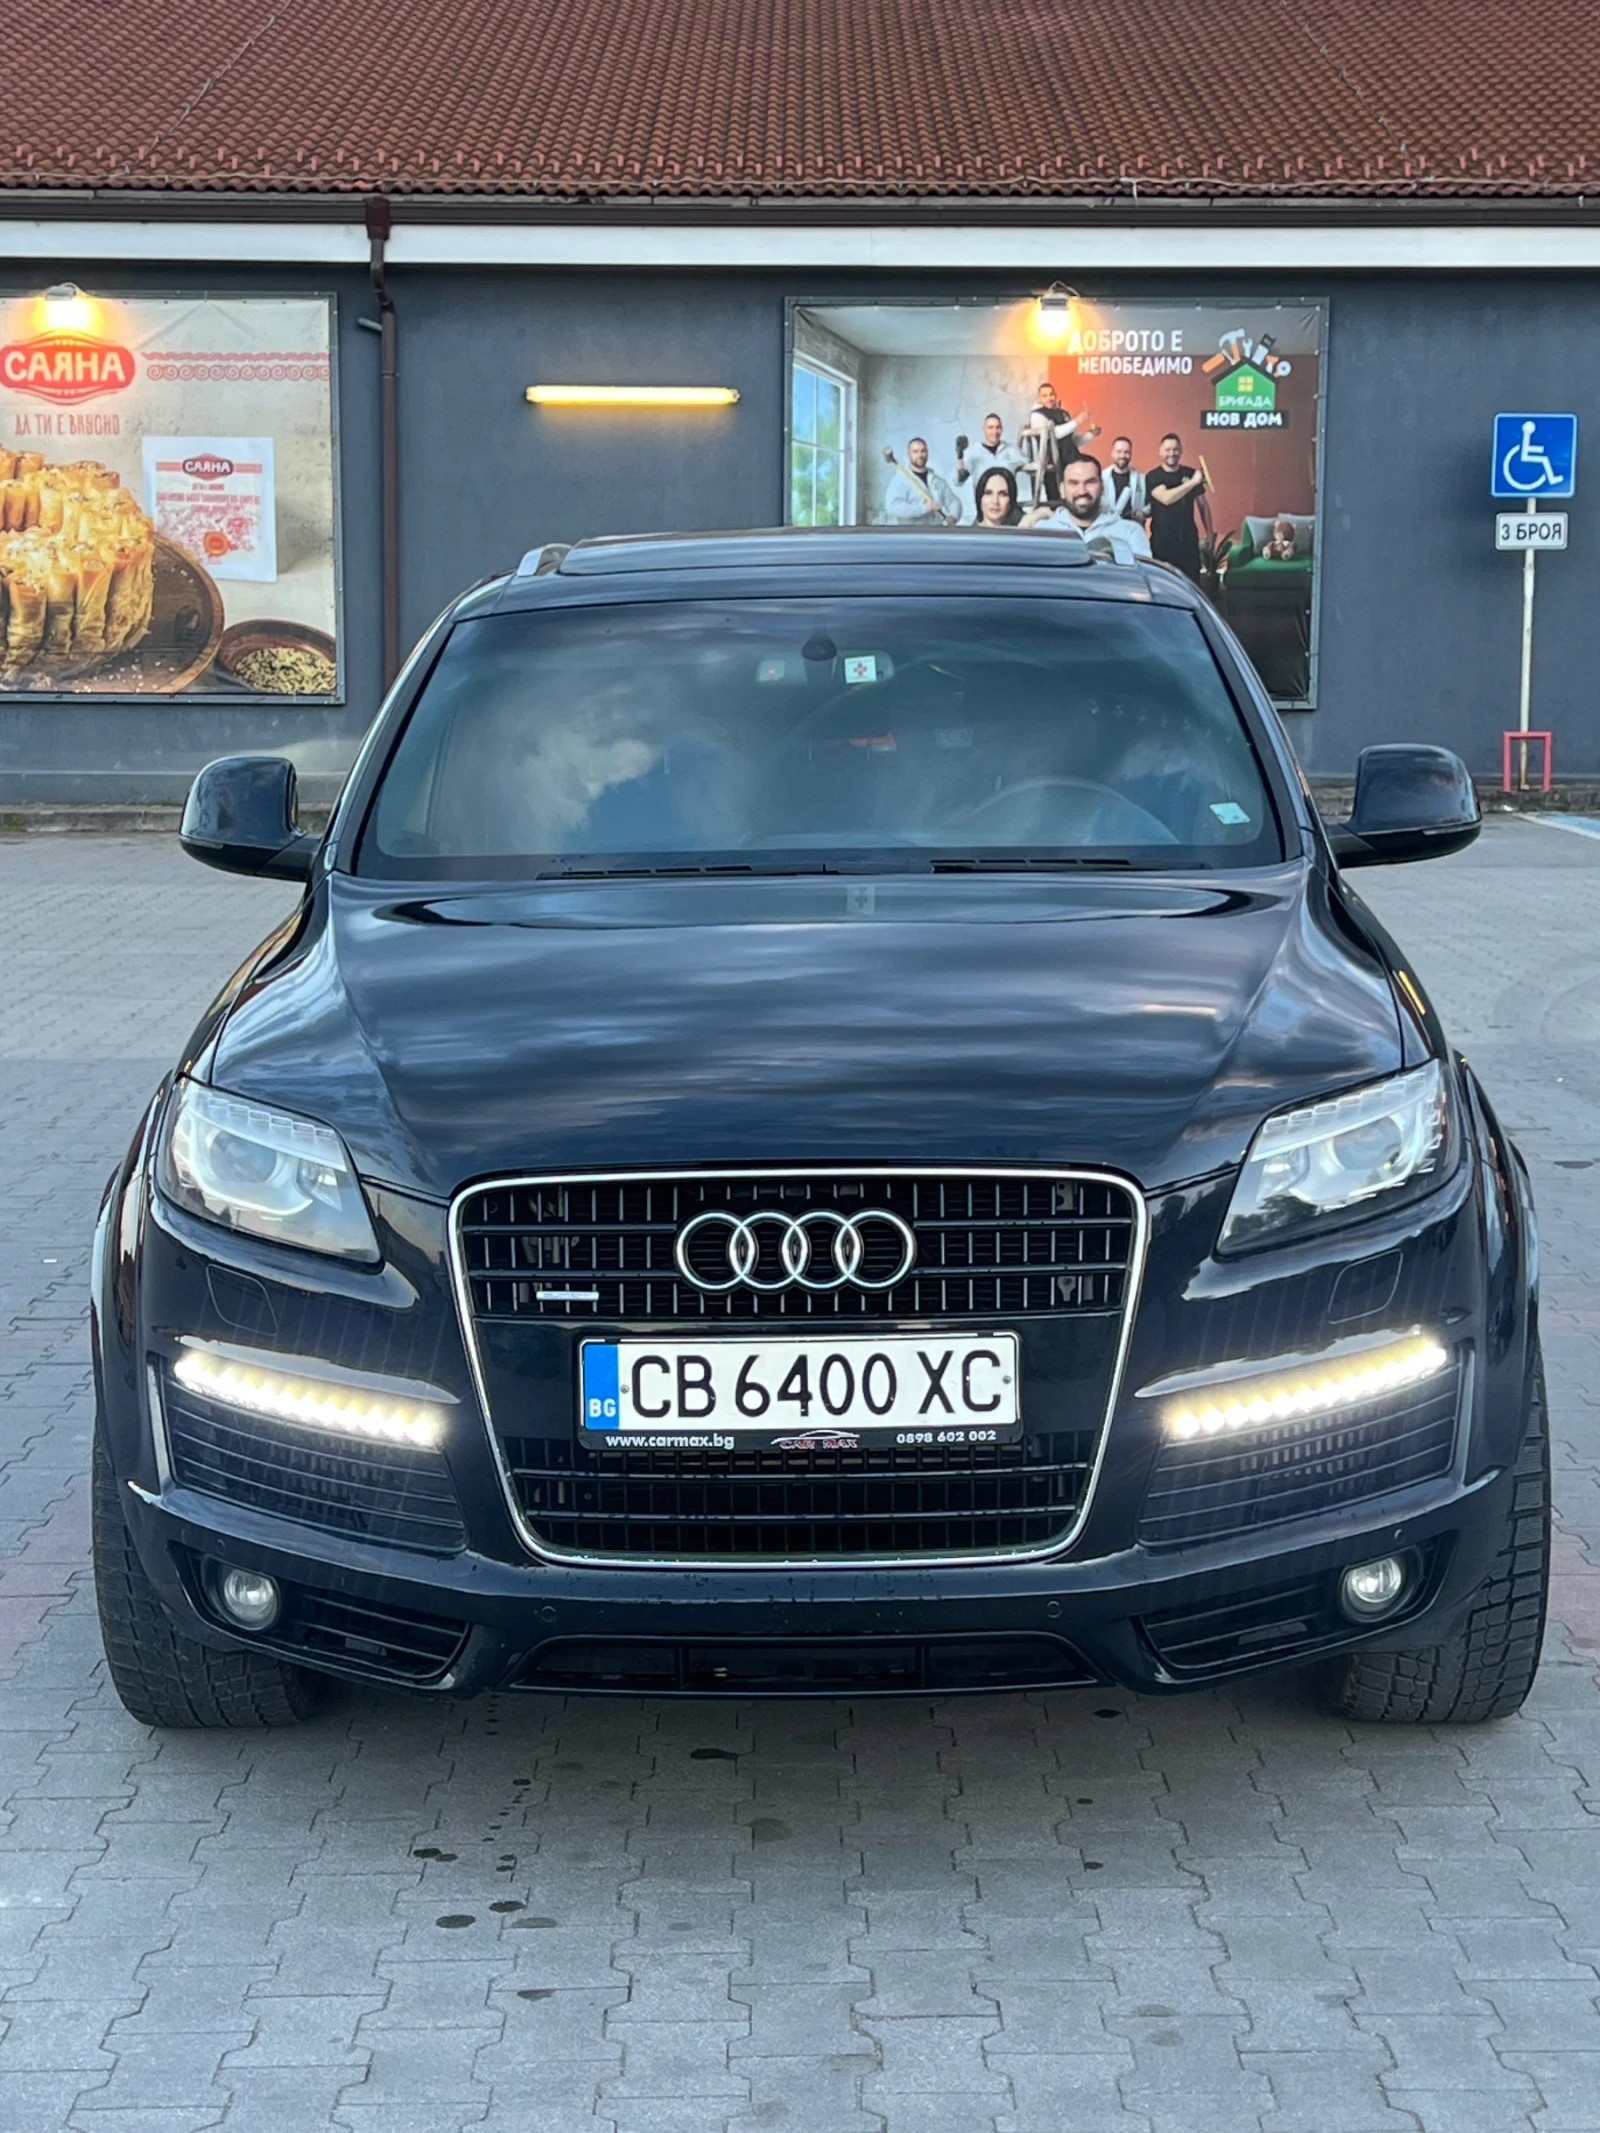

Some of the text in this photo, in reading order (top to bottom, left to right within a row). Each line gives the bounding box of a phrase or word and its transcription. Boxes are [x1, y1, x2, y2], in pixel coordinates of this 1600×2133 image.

[1067, 330, 1183, 354] ДОБРОТО Е
[4, 351, 126, 382] САЯНА
[1078, 356, 1192, 376] НЕПОБЕДИМО
[1219, 395, 1272, 408] БРИГАДА
[69, 414, 120, 435] ВКУСНО
[1206, 412, 1282, 428] НОВ ДОМ
[185, 461, 231, 473] САЯНА
[1502, 523, 1562, 540] 3 БРОЯ
[734, 1353, 897, 1418] 6400
[589, 1399, 616, 1418] BG
[605, 1435, 735, 1450] www.carmax.bg
[823, 1438, 859, 1449] MAX
[896, 1430, 996, 1444] 0898 602 002
